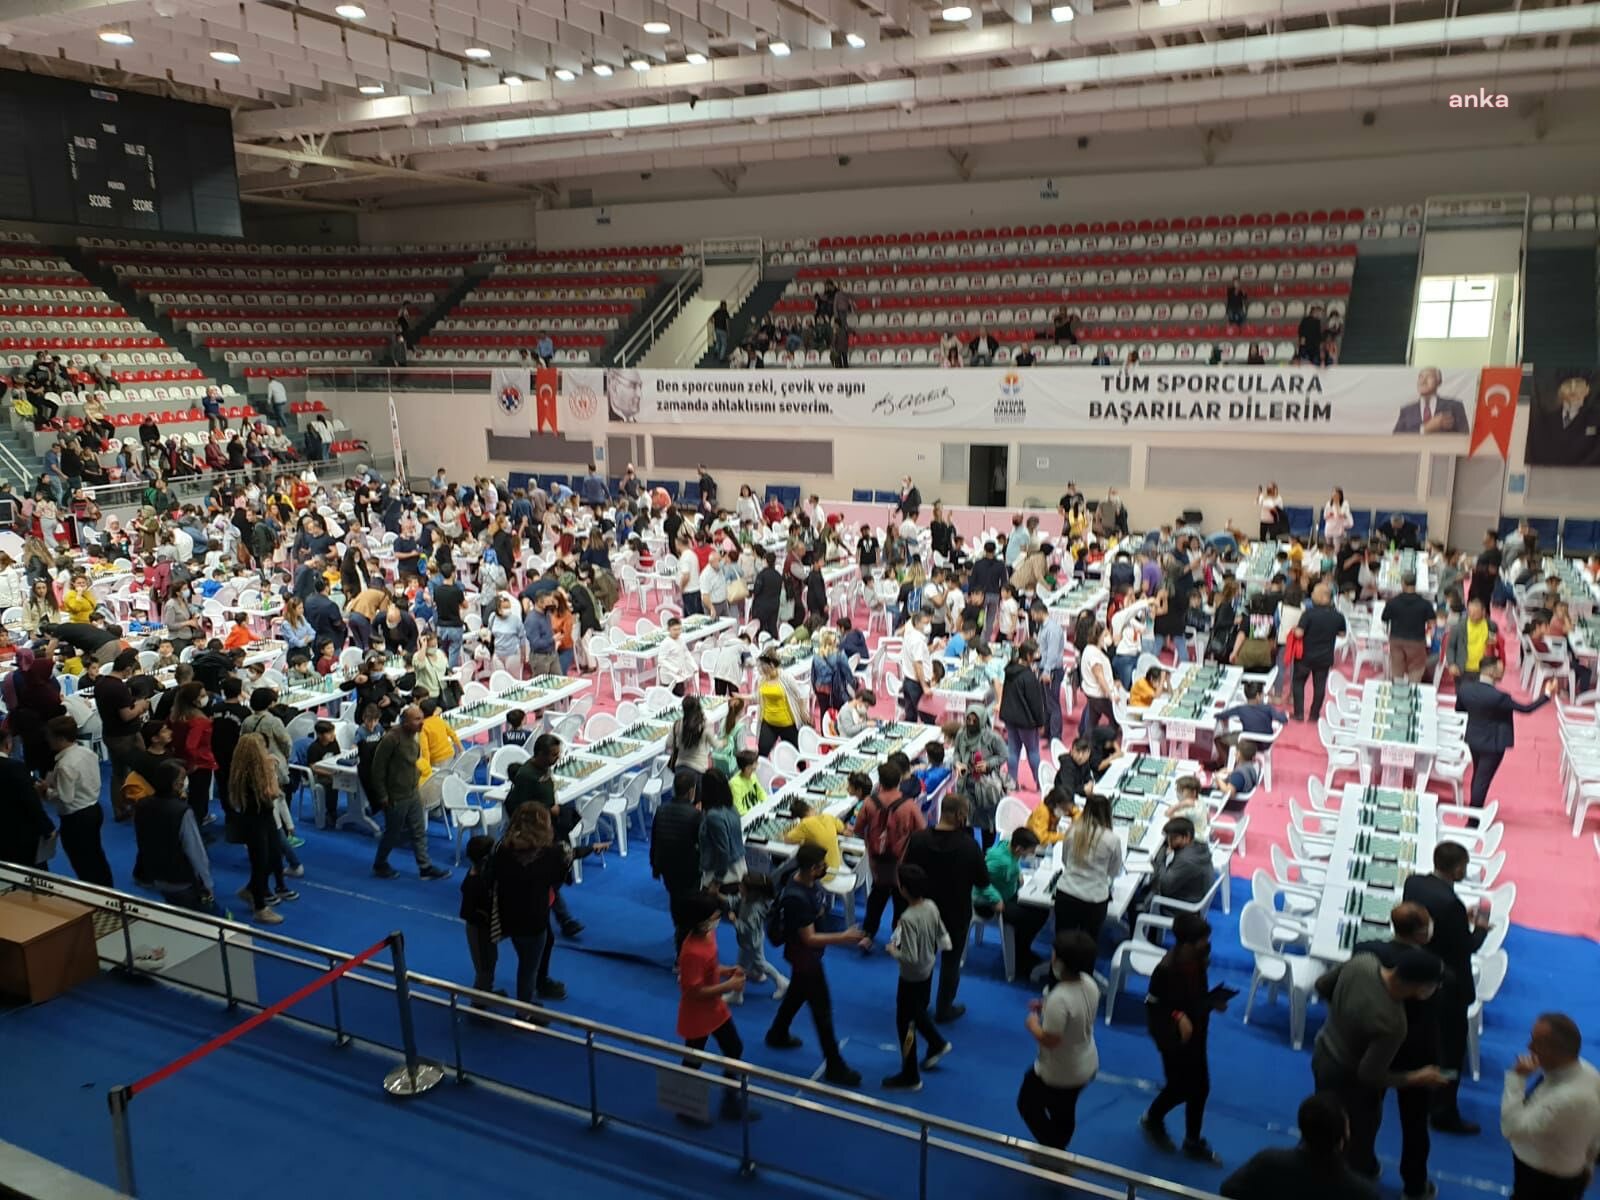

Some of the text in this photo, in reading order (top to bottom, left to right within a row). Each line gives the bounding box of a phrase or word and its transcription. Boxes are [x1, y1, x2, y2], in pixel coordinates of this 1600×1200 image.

[88, 194, 113, 208] SCORE
[132, 198, 154, 213] SCORE
[656, 378, 866, 397] Ben sporcunun zeki, çevik ve aynı
[1101, 369, 1323, 395] TÜM SPORCULARA
[656, 398, 834, 414] zamanda ahlaklısını severim.
[1089, 396, 1333, 425] BAŞARILAR DİLERİM
